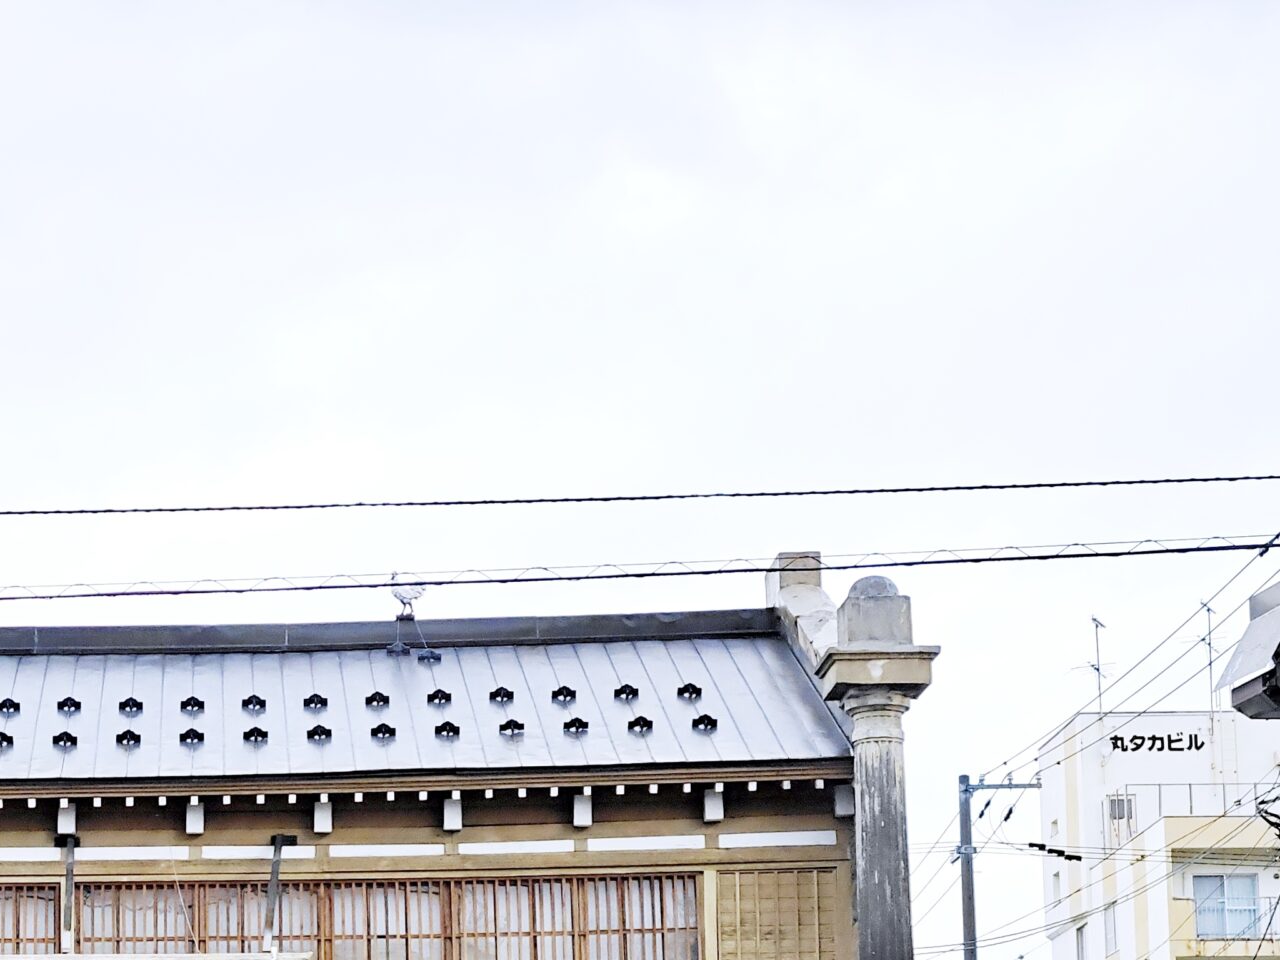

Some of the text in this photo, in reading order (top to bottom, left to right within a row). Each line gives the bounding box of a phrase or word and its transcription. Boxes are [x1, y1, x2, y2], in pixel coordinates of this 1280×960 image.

[1109, 732, 1205, 752] 丸タカビル
